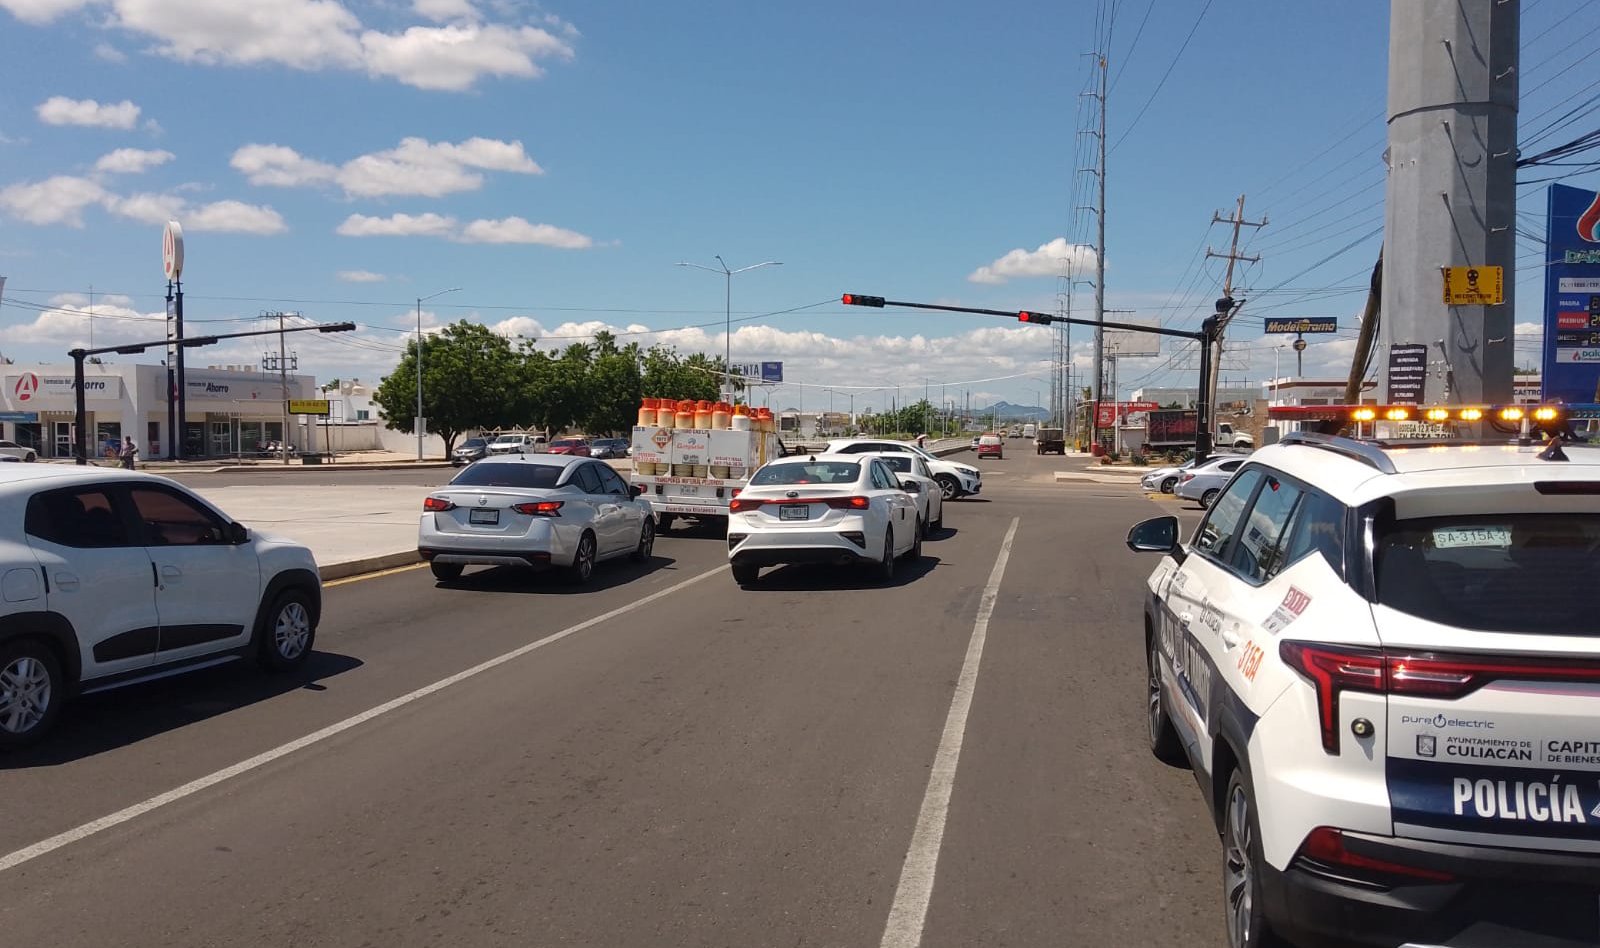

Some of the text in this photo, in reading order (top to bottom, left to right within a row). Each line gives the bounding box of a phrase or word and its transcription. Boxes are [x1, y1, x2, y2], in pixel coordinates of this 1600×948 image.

[206, 382, 229, 393] Ahorro
[1238, 640, 1264, 682] 315A
[1402, 714, 1495, 729] pure electric
[1447, 736, 1518, 748] AYUNTAMIENTO
[1548, 755, 1562, 763] DE
[1453, 774, 1587, 824] POLICÍA
